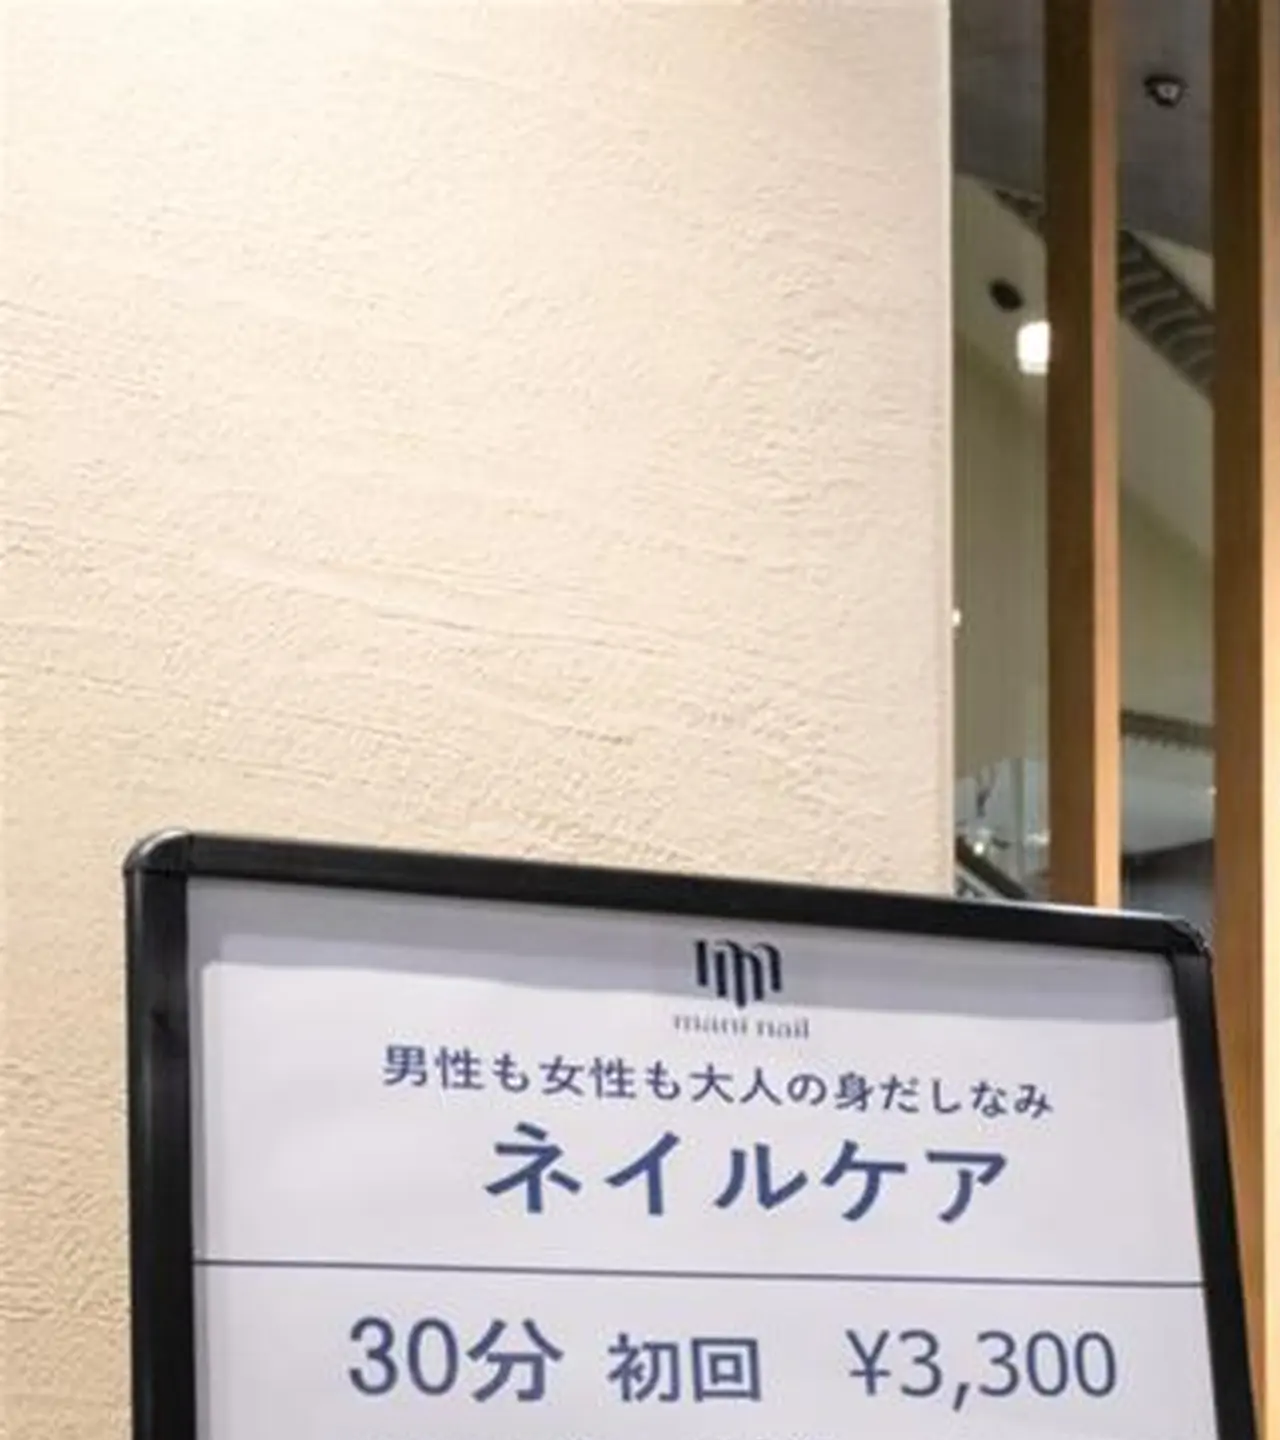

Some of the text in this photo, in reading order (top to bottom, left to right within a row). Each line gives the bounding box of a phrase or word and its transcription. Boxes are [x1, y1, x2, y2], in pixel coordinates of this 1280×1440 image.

[756, 1015, 810, 1039] nail
[382, 1043, 1052, 1120] 男性も女性も大人の身だしなみ
[484, 1121, 1007, 1222] ネイルケア
[347, 1317, 1118, 1413] 30分 初回 ¥3,300
